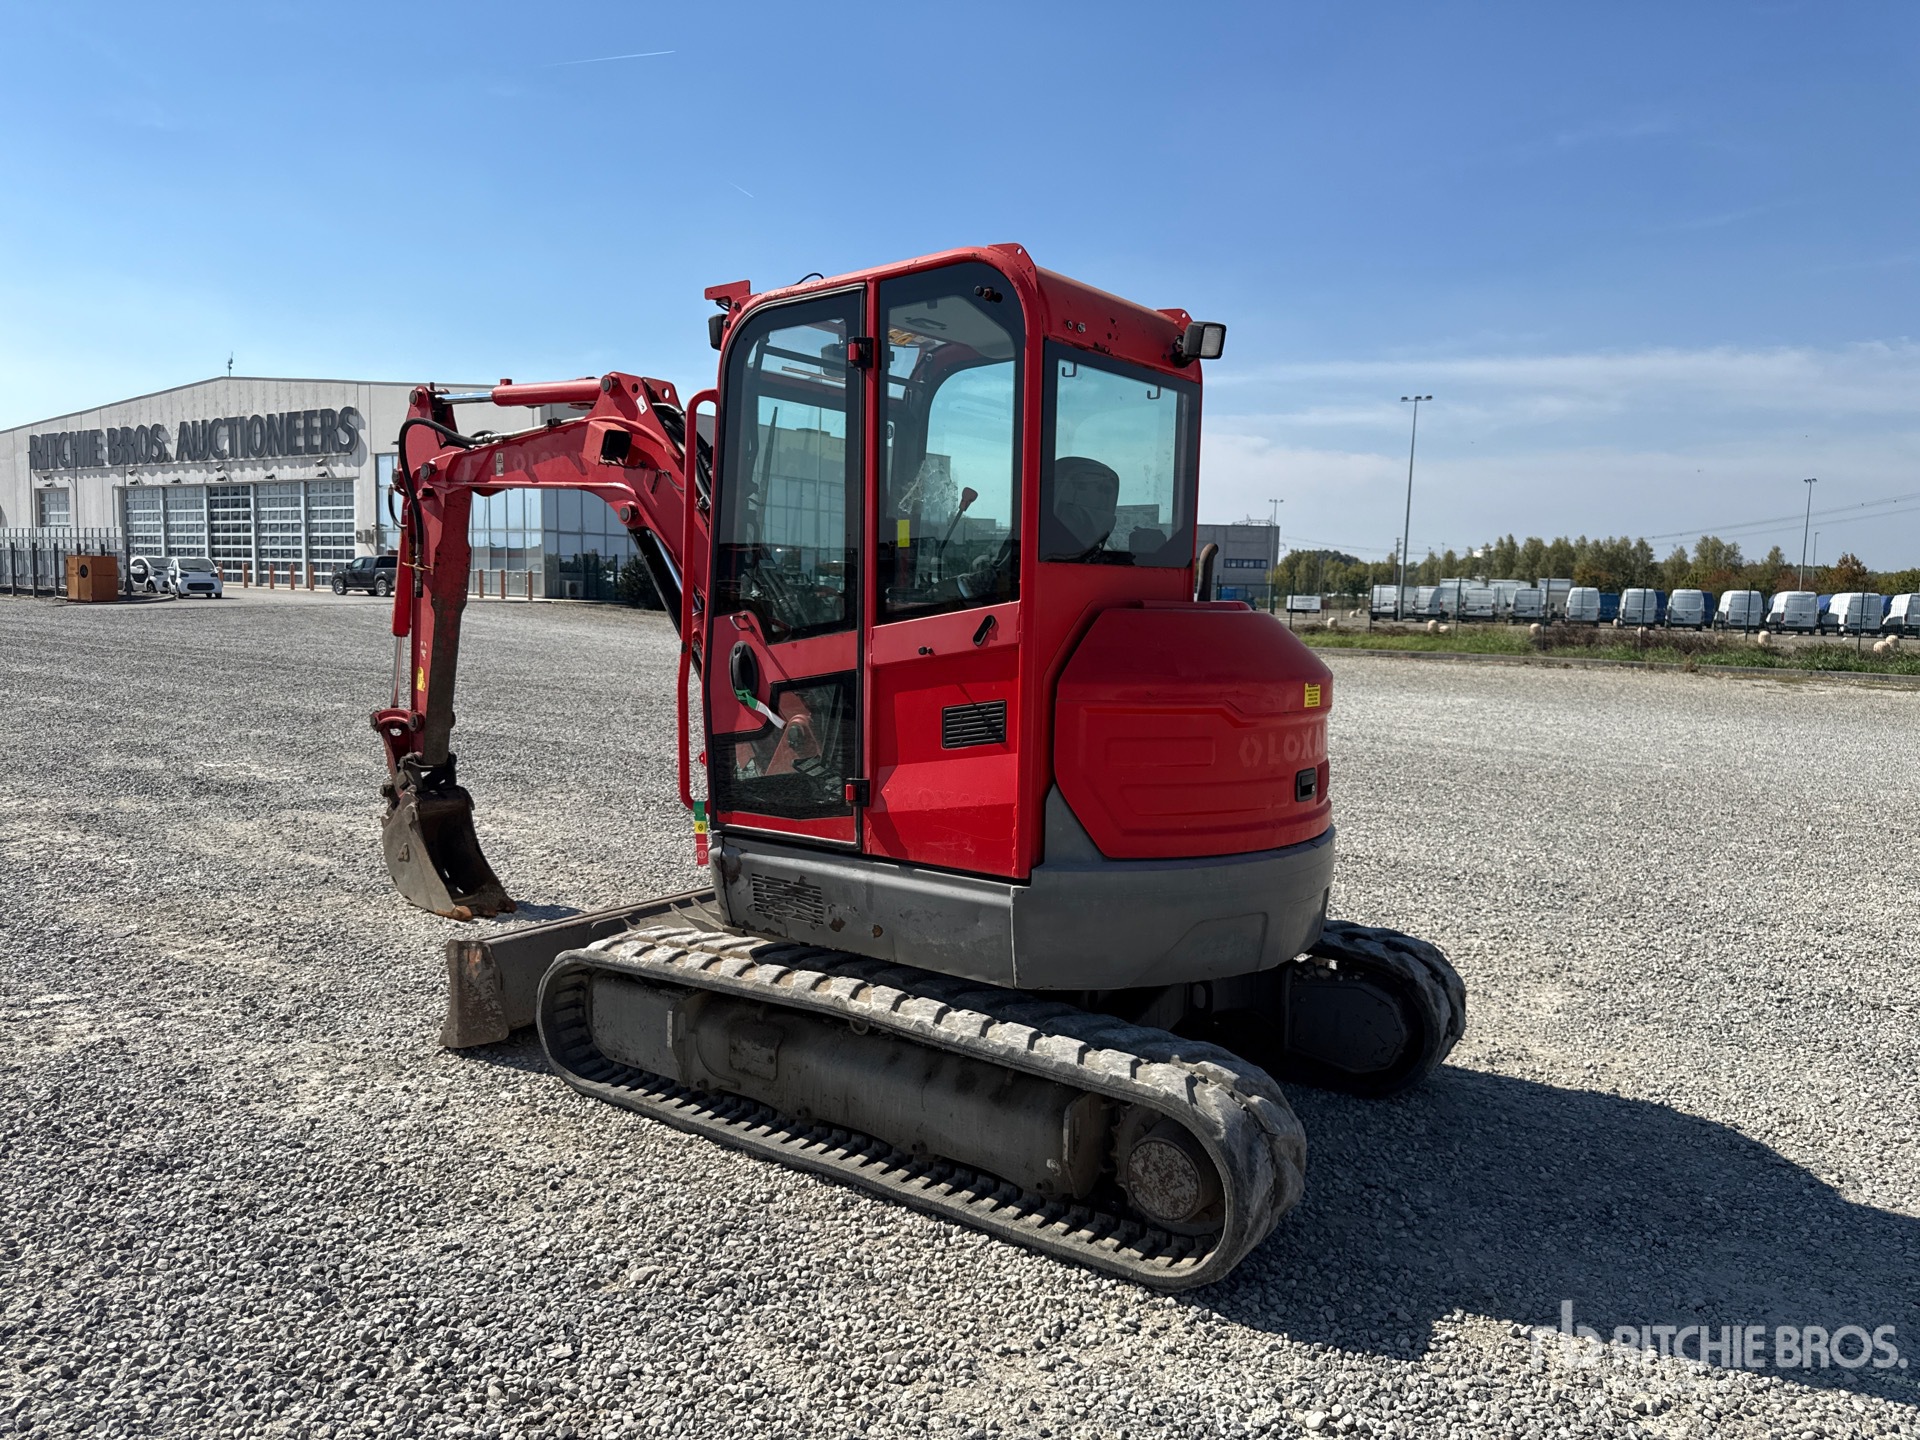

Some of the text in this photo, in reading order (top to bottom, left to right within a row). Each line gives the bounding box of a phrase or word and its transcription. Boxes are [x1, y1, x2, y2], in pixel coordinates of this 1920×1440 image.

[29, 406, 359, 470] RITCHIE BROS. AUCTIONEERS
